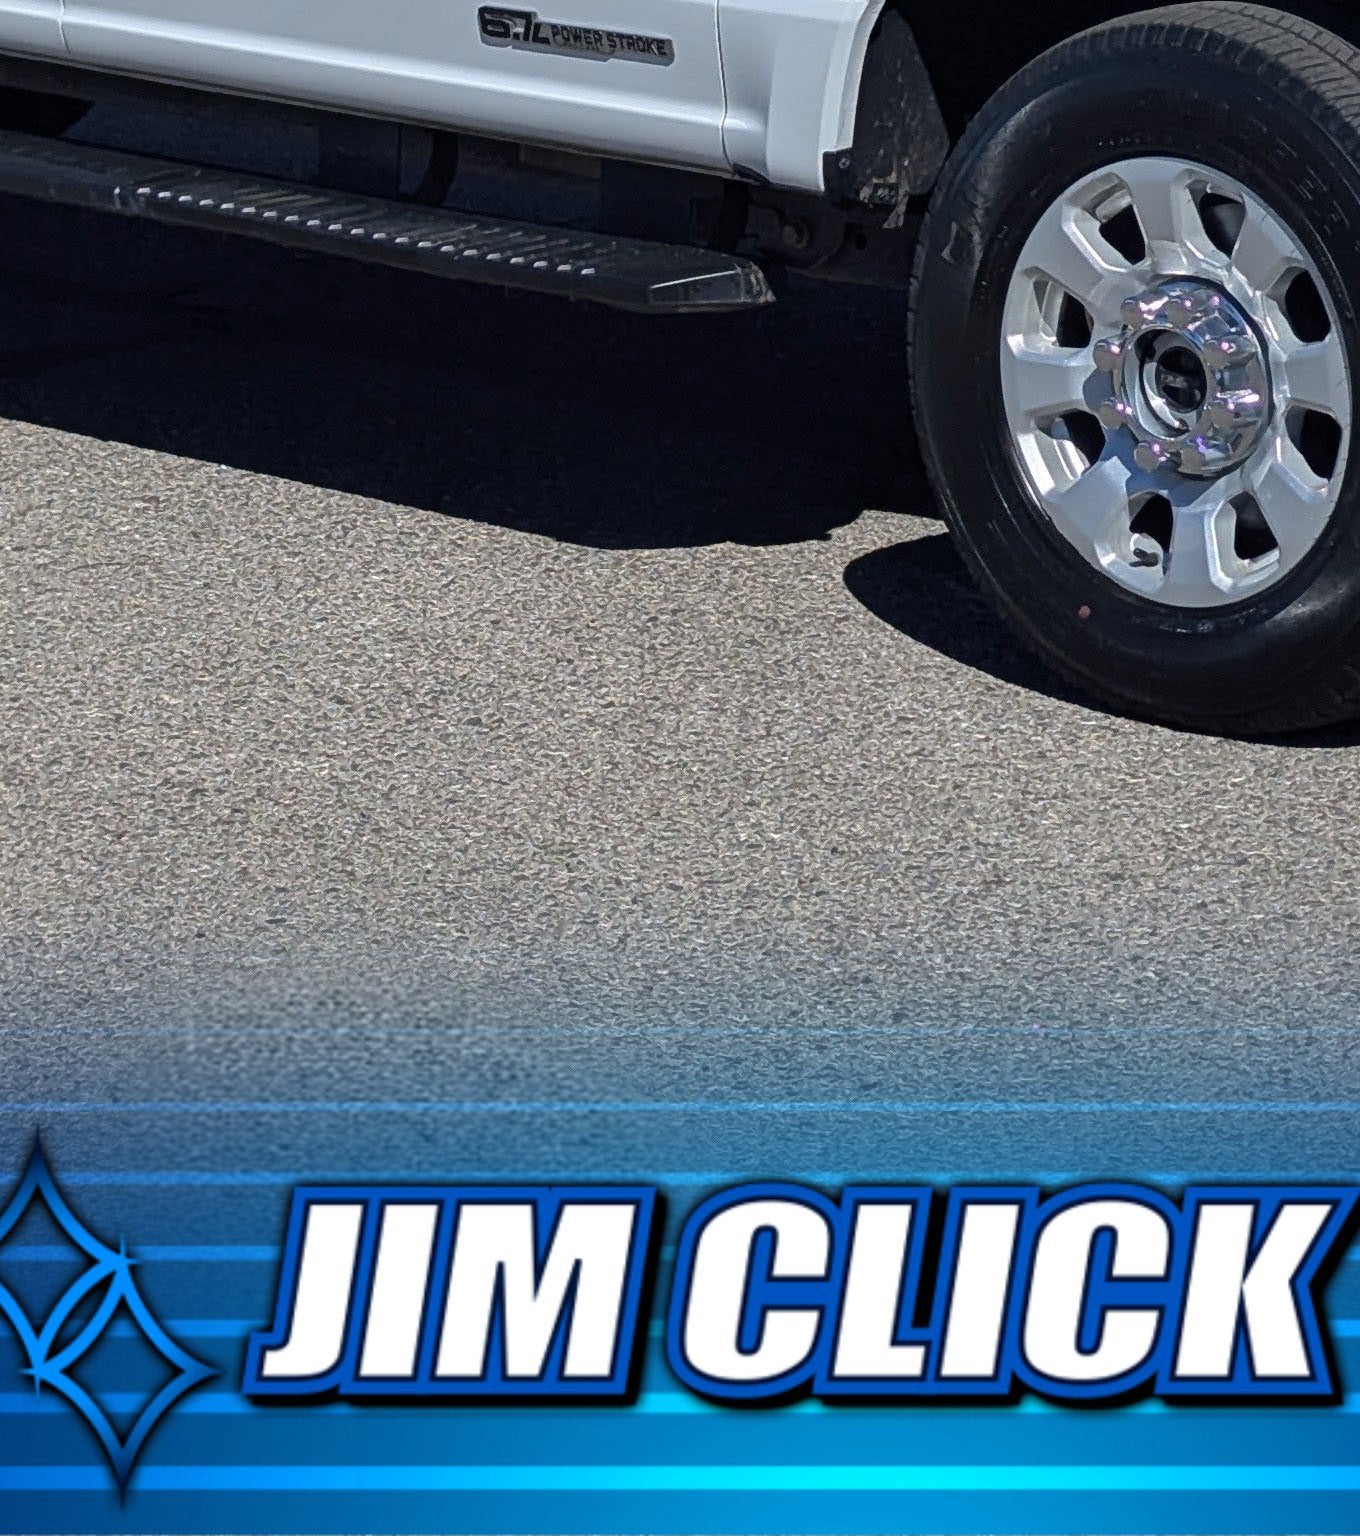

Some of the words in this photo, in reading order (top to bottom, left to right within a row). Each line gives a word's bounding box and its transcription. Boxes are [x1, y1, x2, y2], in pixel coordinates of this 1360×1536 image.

[478, 4, 550, 46] 6.7L
[550, 24, 604, 48] POWER
[606, 30, 669, 57] STROKE
